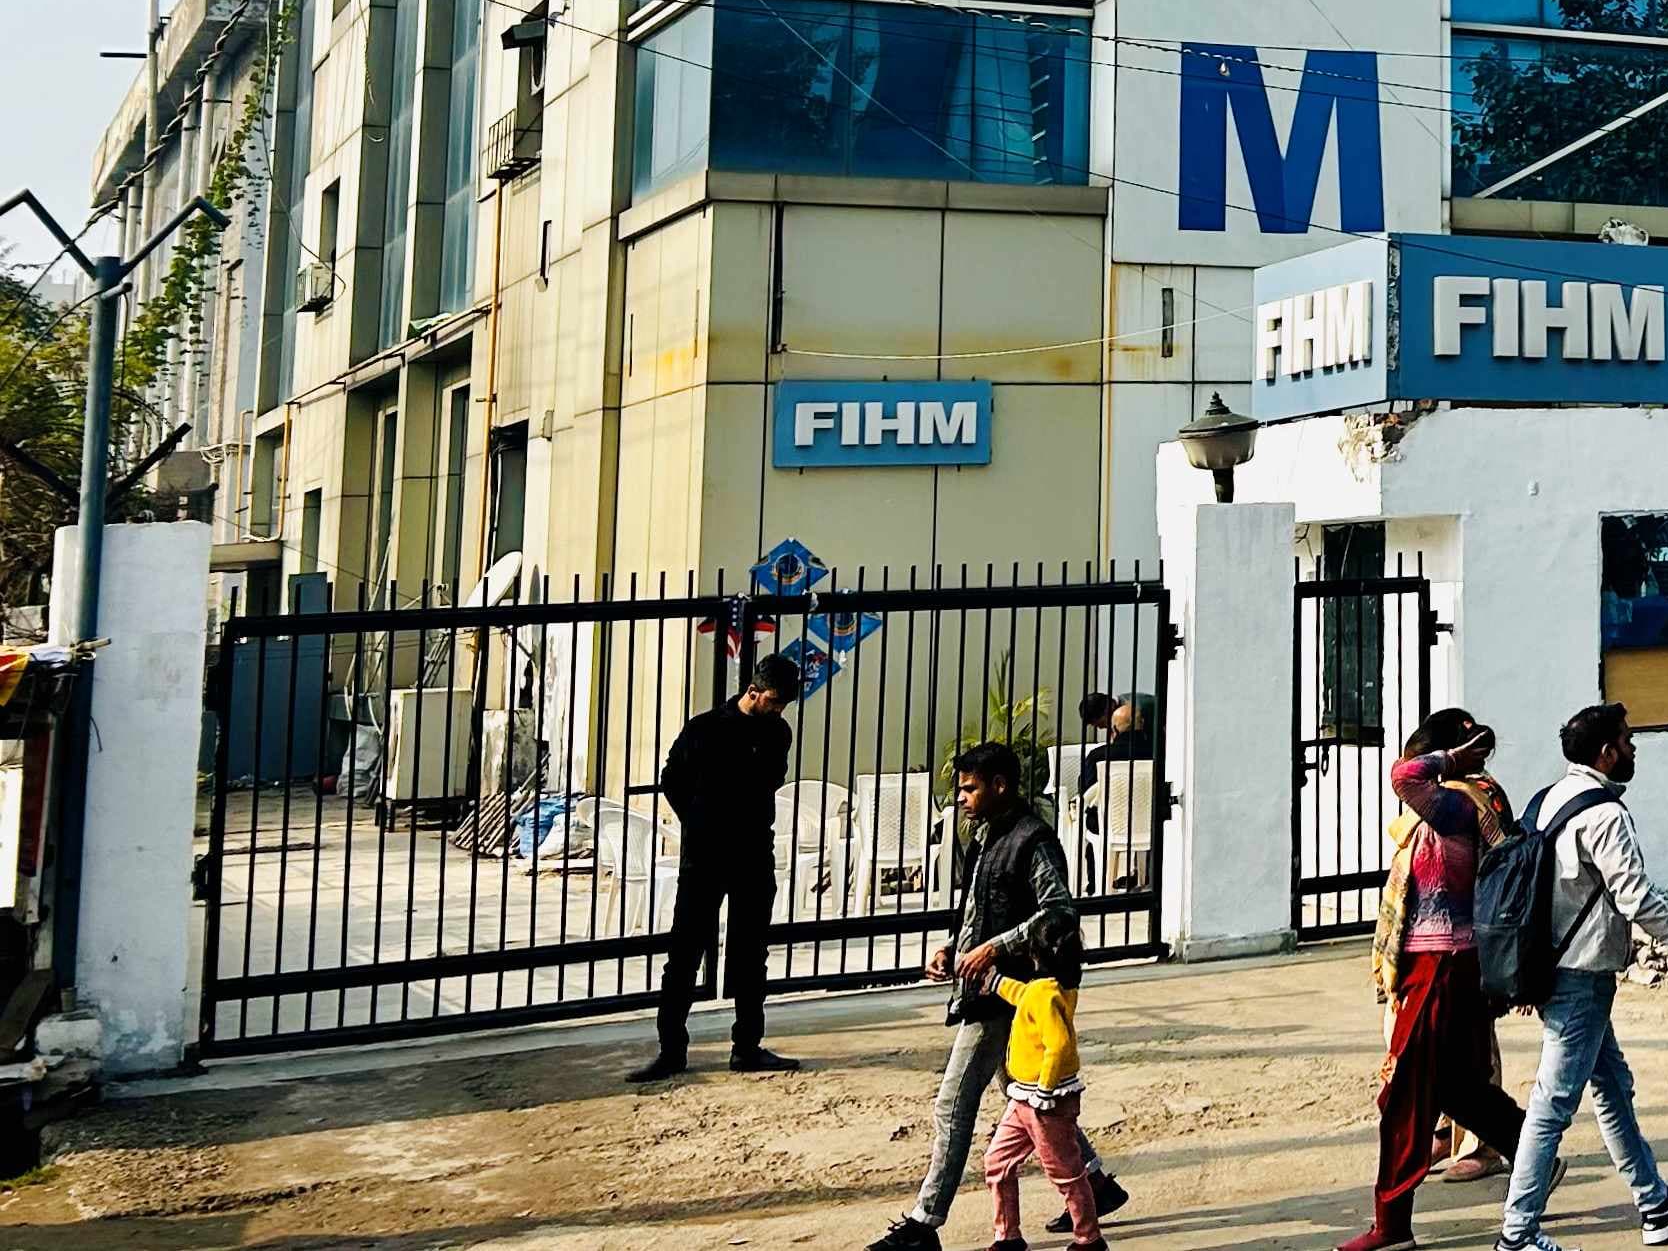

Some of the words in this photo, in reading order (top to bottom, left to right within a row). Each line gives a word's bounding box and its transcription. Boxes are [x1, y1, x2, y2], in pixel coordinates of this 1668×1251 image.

[1257, 278, 1373, 382] FIHM
[1433, 275, 1665, 361] FIHM
[795, 401, 977, 446] FIHM
